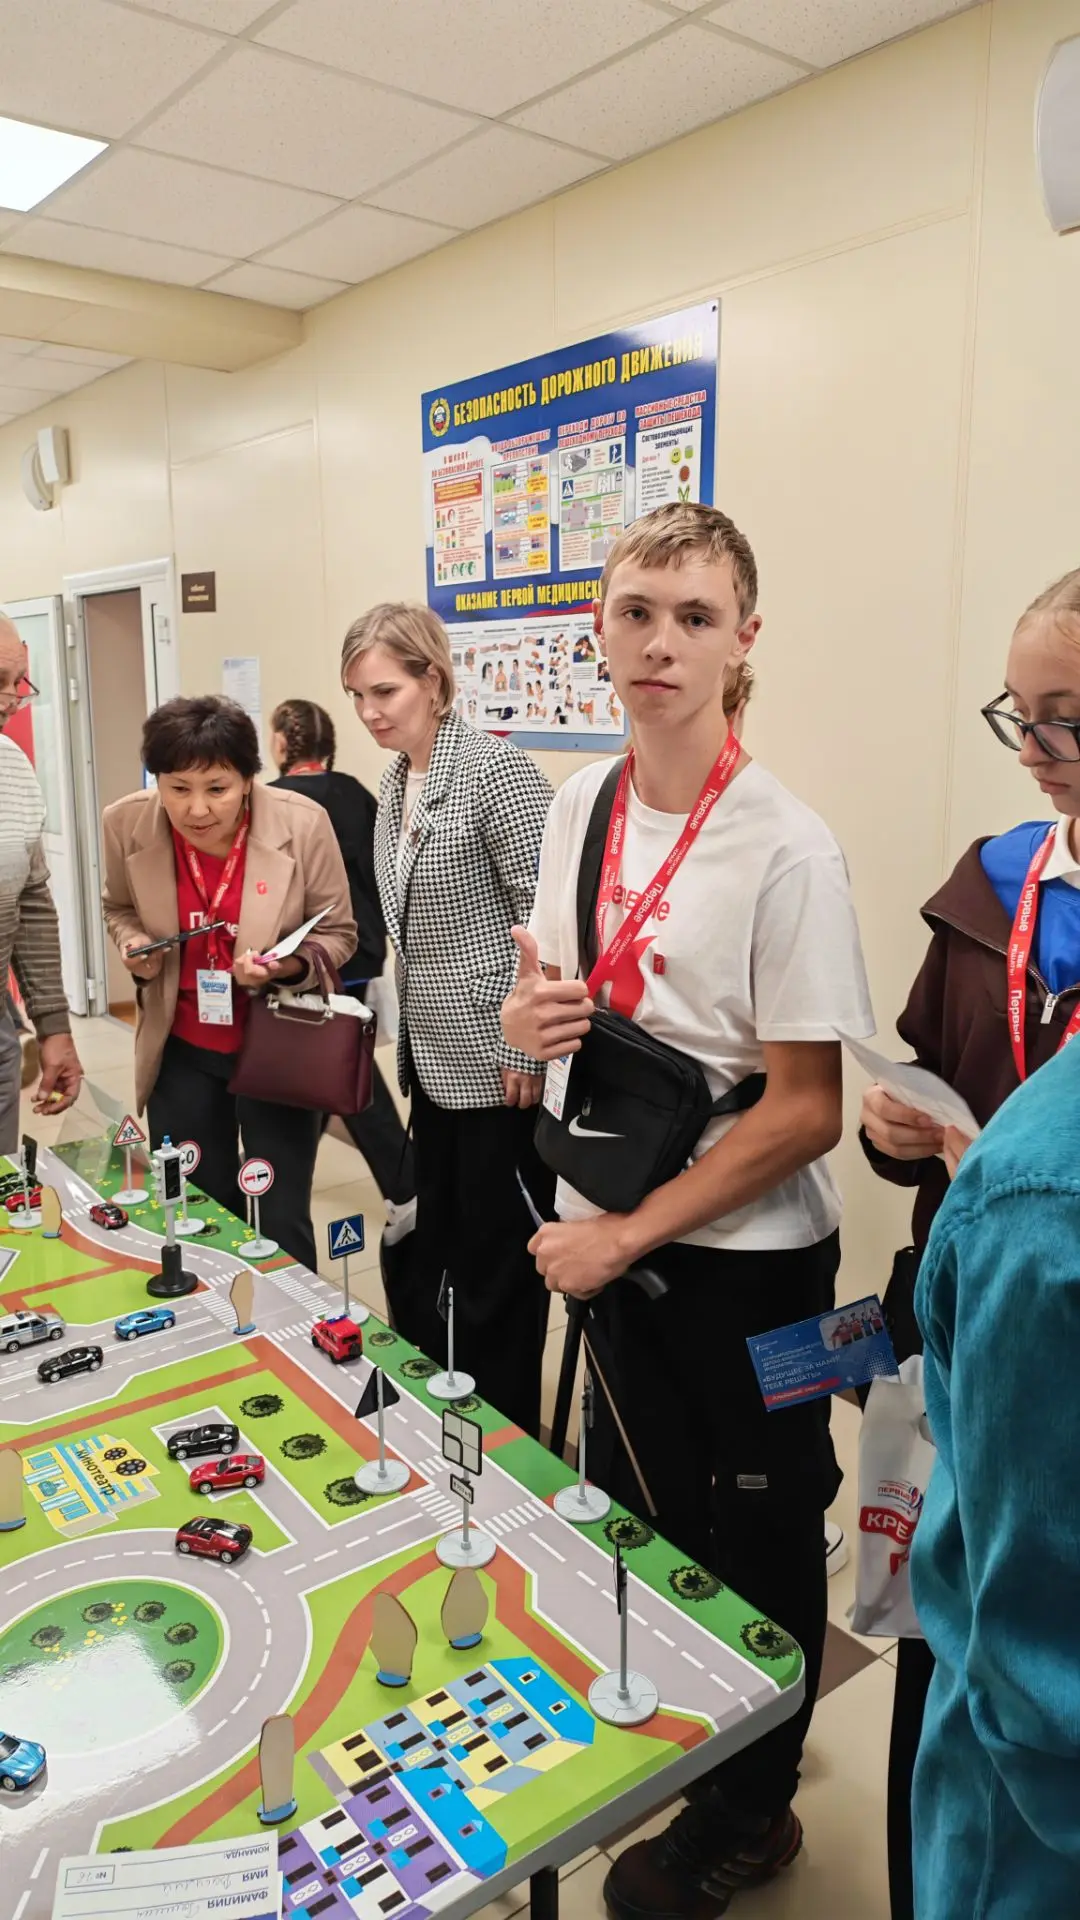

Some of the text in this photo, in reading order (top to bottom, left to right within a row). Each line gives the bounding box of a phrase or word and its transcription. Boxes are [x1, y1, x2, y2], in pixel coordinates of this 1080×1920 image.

[453, 334, 703, 427] БЕЗОПАСНОСТЬ ДОРОЖНОГО ДВИЖЕНИЯ
[456, 591, 498, 611] ОКАЗАНИЕ
[500, 583, 534, 608] ПЕРВОЙ
[690, 788, 719, 830] Первые
[611, 813, 625, 855] Первые
[634, 883, 665, 923] Первые
[1019, 883, 1036, 932] Первые
[1009, 989, 1023, 1043] Первые
[866, 1512, 909, 1540] КРЕ
[224, 1845, 270, 1860] КОМАНДА:
[242, 1866, 269, 1882] ИМЯ
[207, 1891, 269, 1909] ФАМИЛИЯ
